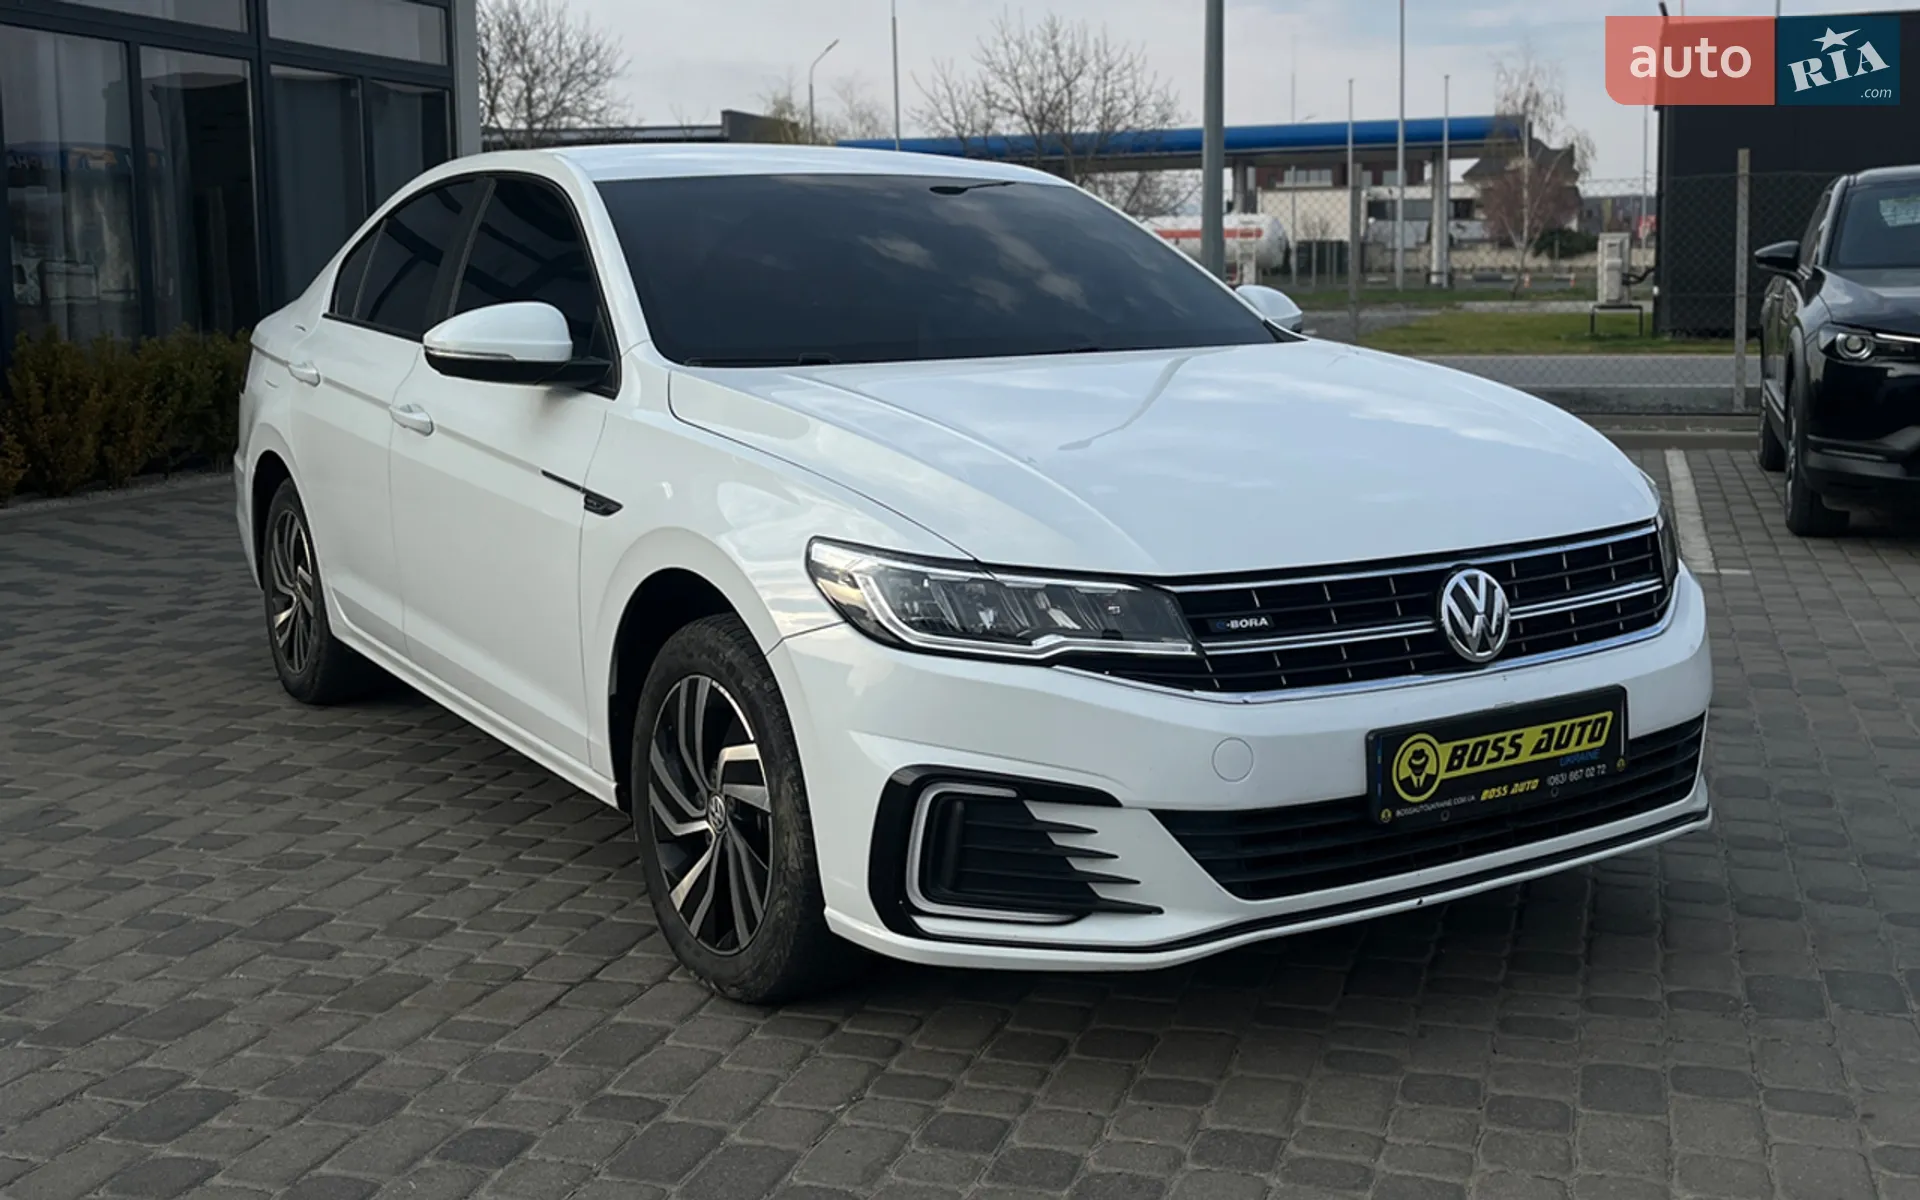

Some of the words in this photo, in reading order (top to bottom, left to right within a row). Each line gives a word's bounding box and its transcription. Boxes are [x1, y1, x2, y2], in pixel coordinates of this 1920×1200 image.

[1446, 733, 1522, 773] BOSS
[1530, 716, 1608, 756] AUTO
[1480, 784, 1509, 801] BOSS
[1510, 778, 1540, 795] AUTO
